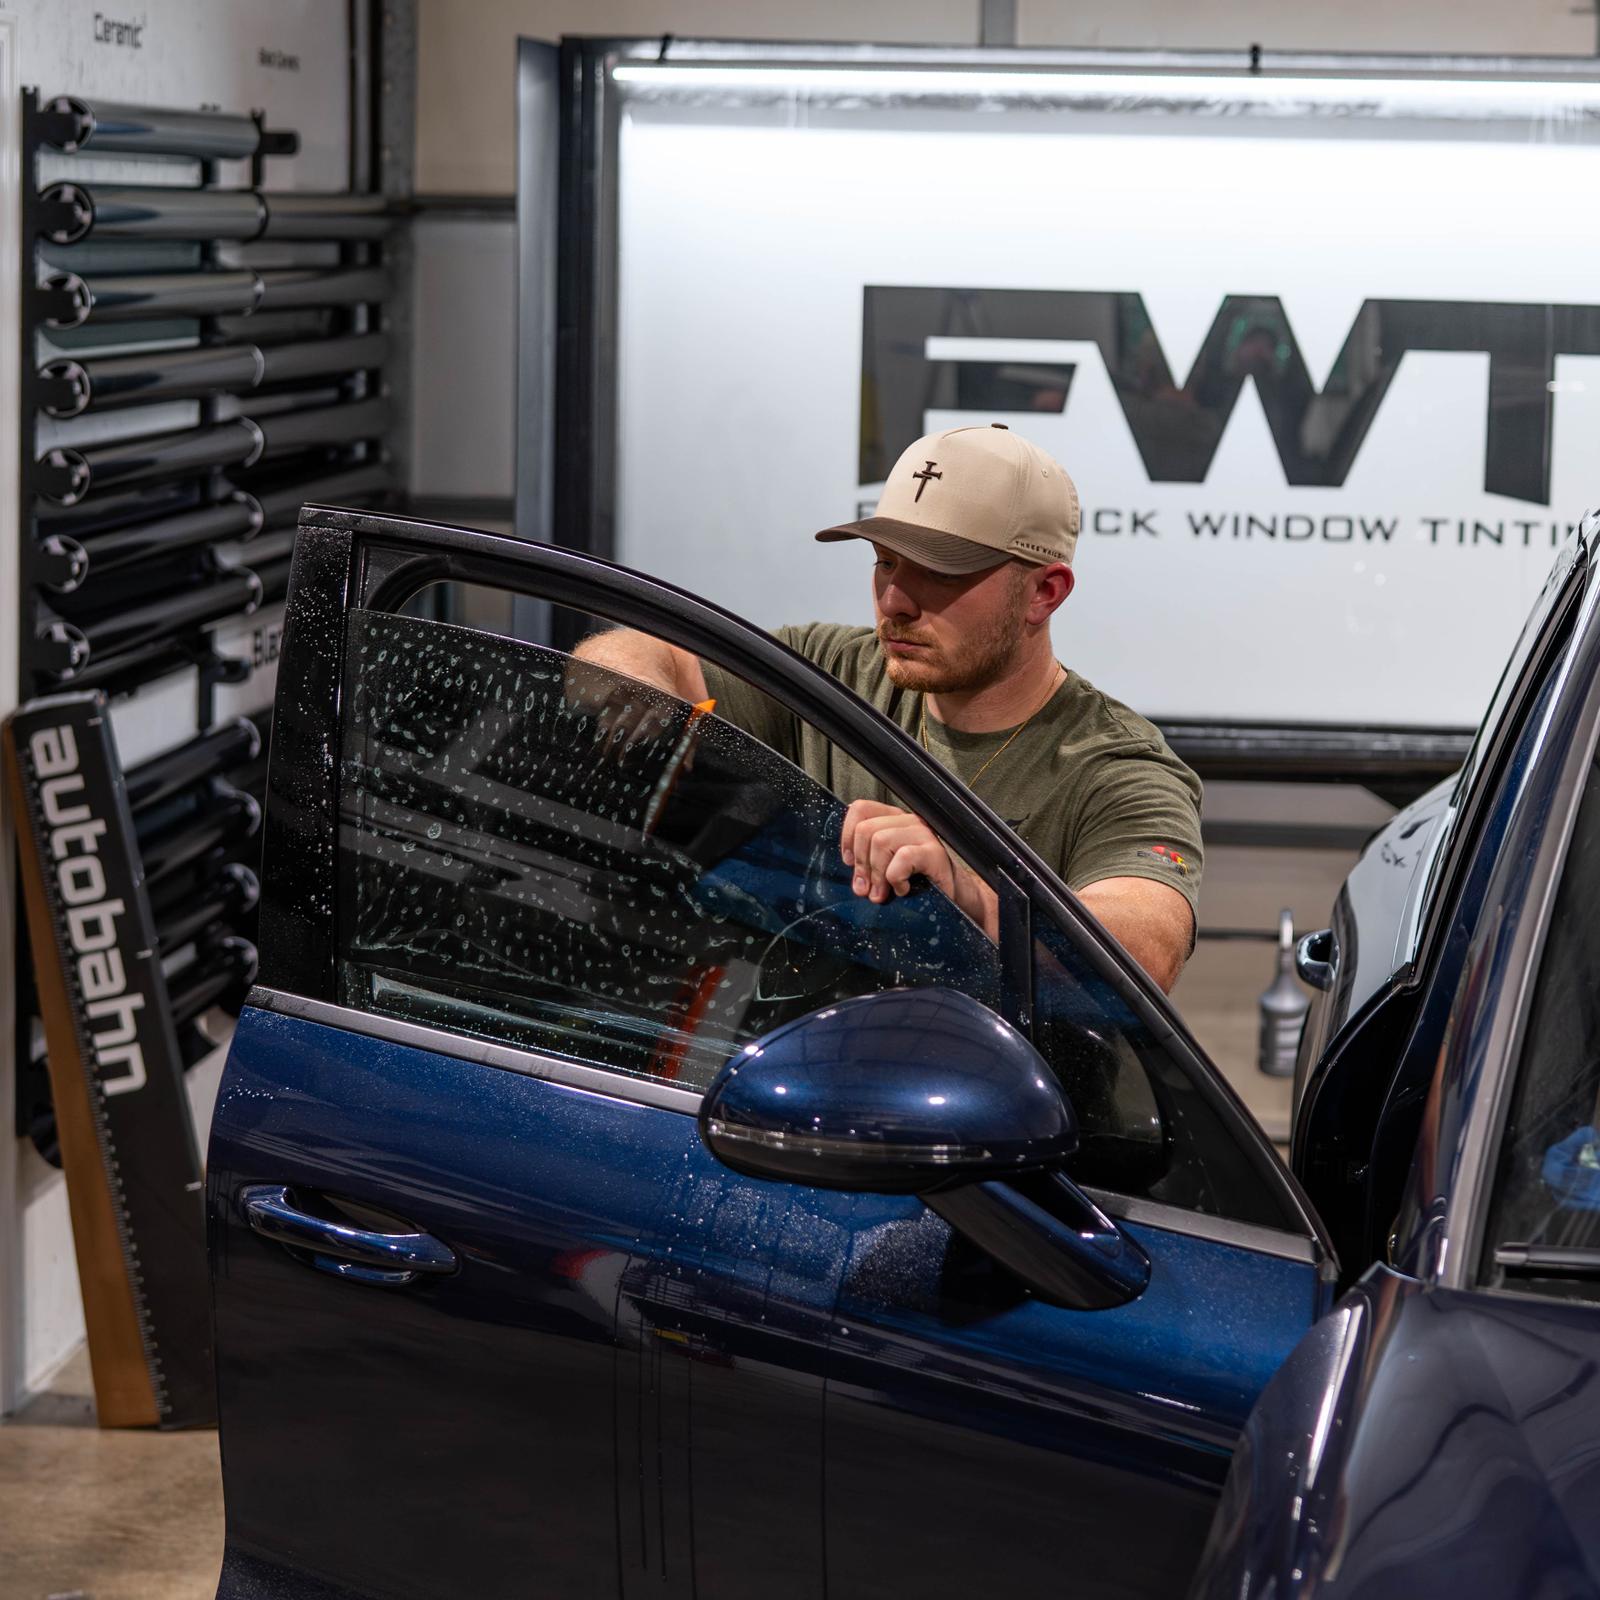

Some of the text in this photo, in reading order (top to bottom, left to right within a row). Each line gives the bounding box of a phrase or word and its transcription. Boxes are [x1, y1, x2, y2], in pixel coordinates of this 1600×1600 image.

[94, 13, 143, 49] Ceramic
[858, 284, 1600, 506] FWT
[1186, 512, 1398, 542] WINDOW
[1015, 540, 1040, 551] THREE
[30, 724, 147, 1097] autobahn
